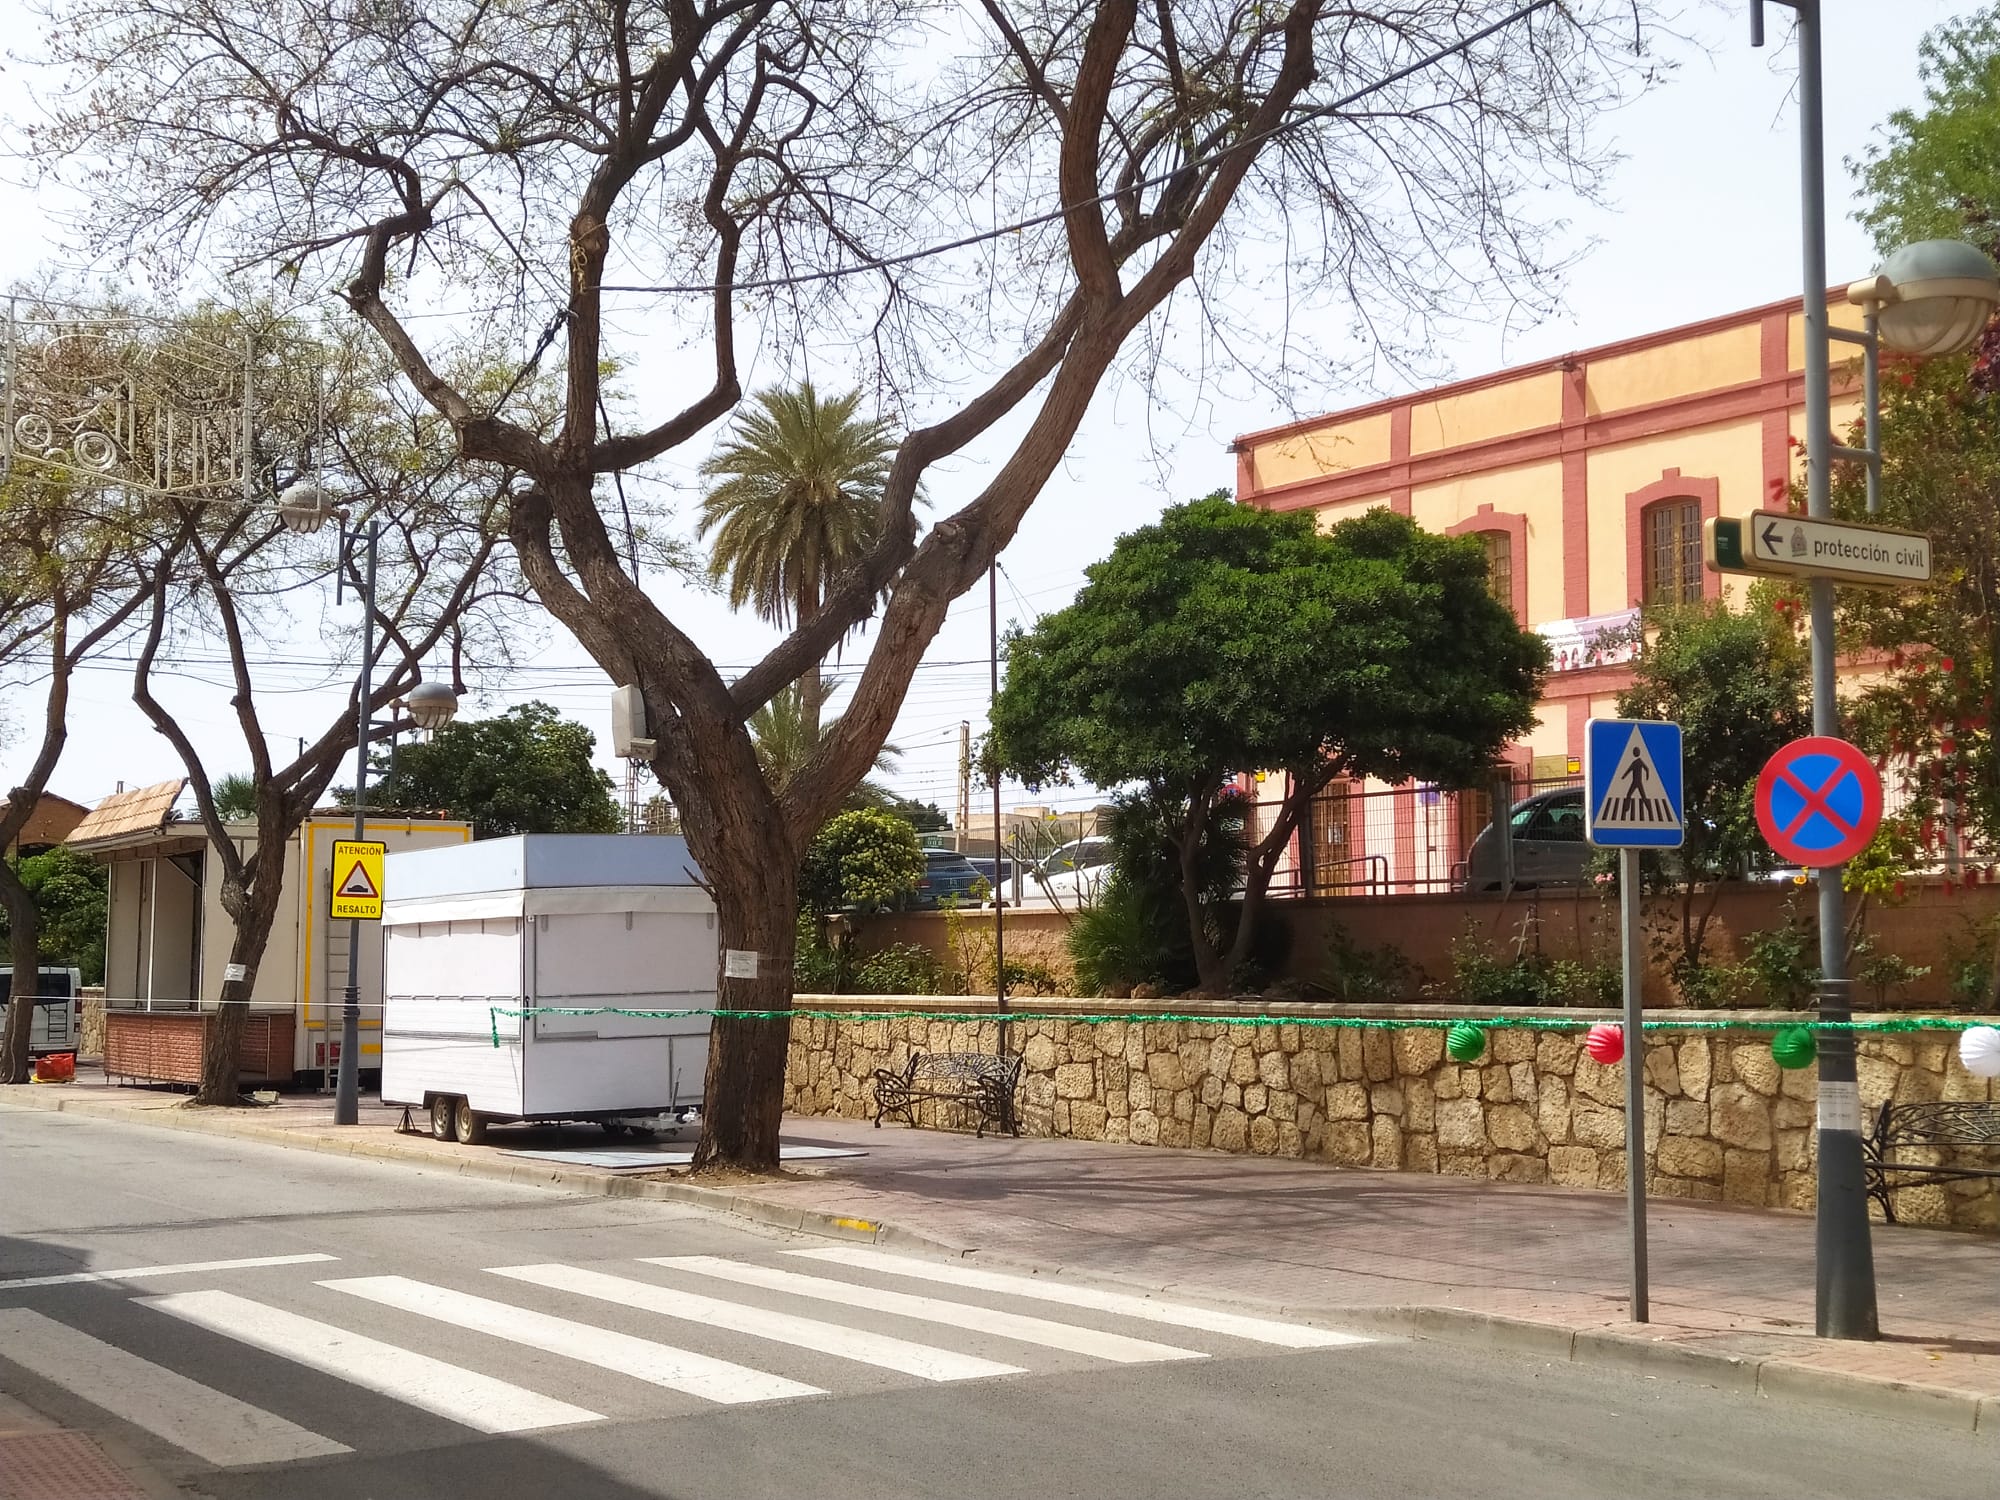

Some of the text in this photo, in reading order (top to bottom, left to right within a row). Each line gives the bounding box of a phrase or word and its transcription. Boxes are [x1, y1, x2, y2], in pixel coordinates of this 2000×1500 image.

[1814, 539, 1924, 567] protección civil
[336, 904, 377, 914] RESALTO
